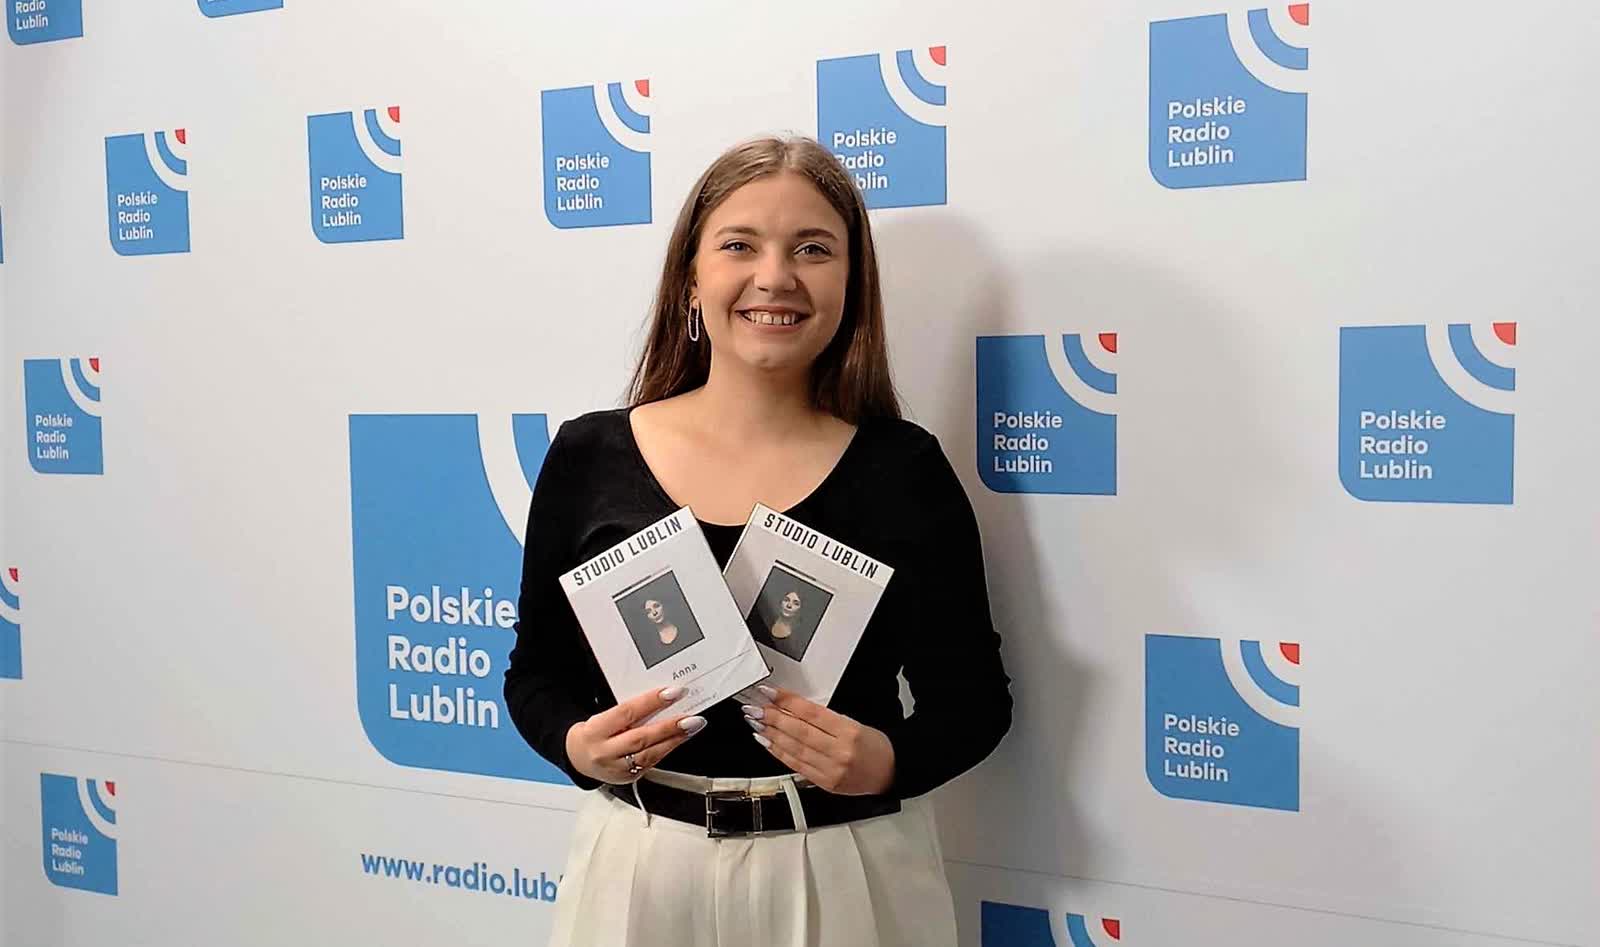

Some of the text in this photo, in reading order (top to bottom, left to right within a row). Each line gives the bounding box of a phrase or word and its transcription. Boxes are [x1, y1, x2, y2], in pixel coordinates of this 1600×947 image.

[16, 14, 49, 31] Lublin
[1167, 95, 1247, 119] Polskie
[833, 127, 898, 149] Polskie
[1167, 121, 1230, 142] Radio
[555, 152, 609, 171] Polskie
[1167, 144, 1234, 167] Lublin
[320, 173, 367, 190] Polskie
[556, 174, 600, 191] Radio
[854, 171, 888, 191] blin
[116, 191, 157, 206] Polskie
[321, 193, 358, 209] Radio
[556, 194, 603, 211] Lublin
[117, 208, 151, 224] Radio
[322, 211, 361, 227] Lublin
[118, 225, 154, 241] Lublin
[35, 413, 73, 428] Polskie
[993, 411, 1063, 428] Polskie
[1359, 410, 1447, 431] Polskie
[36, 430, 66, 445] Radio
[993, 433, 1049, 451] Radio
[1359, 435, 1429, 455] Radio
[36, 446, 70, 461] Lublin
[994, 455, 1053, 473] Lublin
[1359, 459, 1433, 480] Lublin
[572, 516, 682, 587] STUDIO LUBLIN
[763, 512, 879, 579] STUDIO LUBLIN
[386, 584, 517, 629] Polskie
[387, 634, 491, 678] Radio
[672, 662, 698, 681] Anna
[388, 683, 499, 729] Lublin
[1163, 713, 1240, 738] Polskie
[1163, 737, 1225, 760] Radio
[1163, 760, 1229, 783] Lublin
[51, 827, 89, 846] Polskie
[51, 843, 82, 860] Radio
[51, 859, 85, 877] Lublin
[360, 852, 564, 903] www.radio.lub
